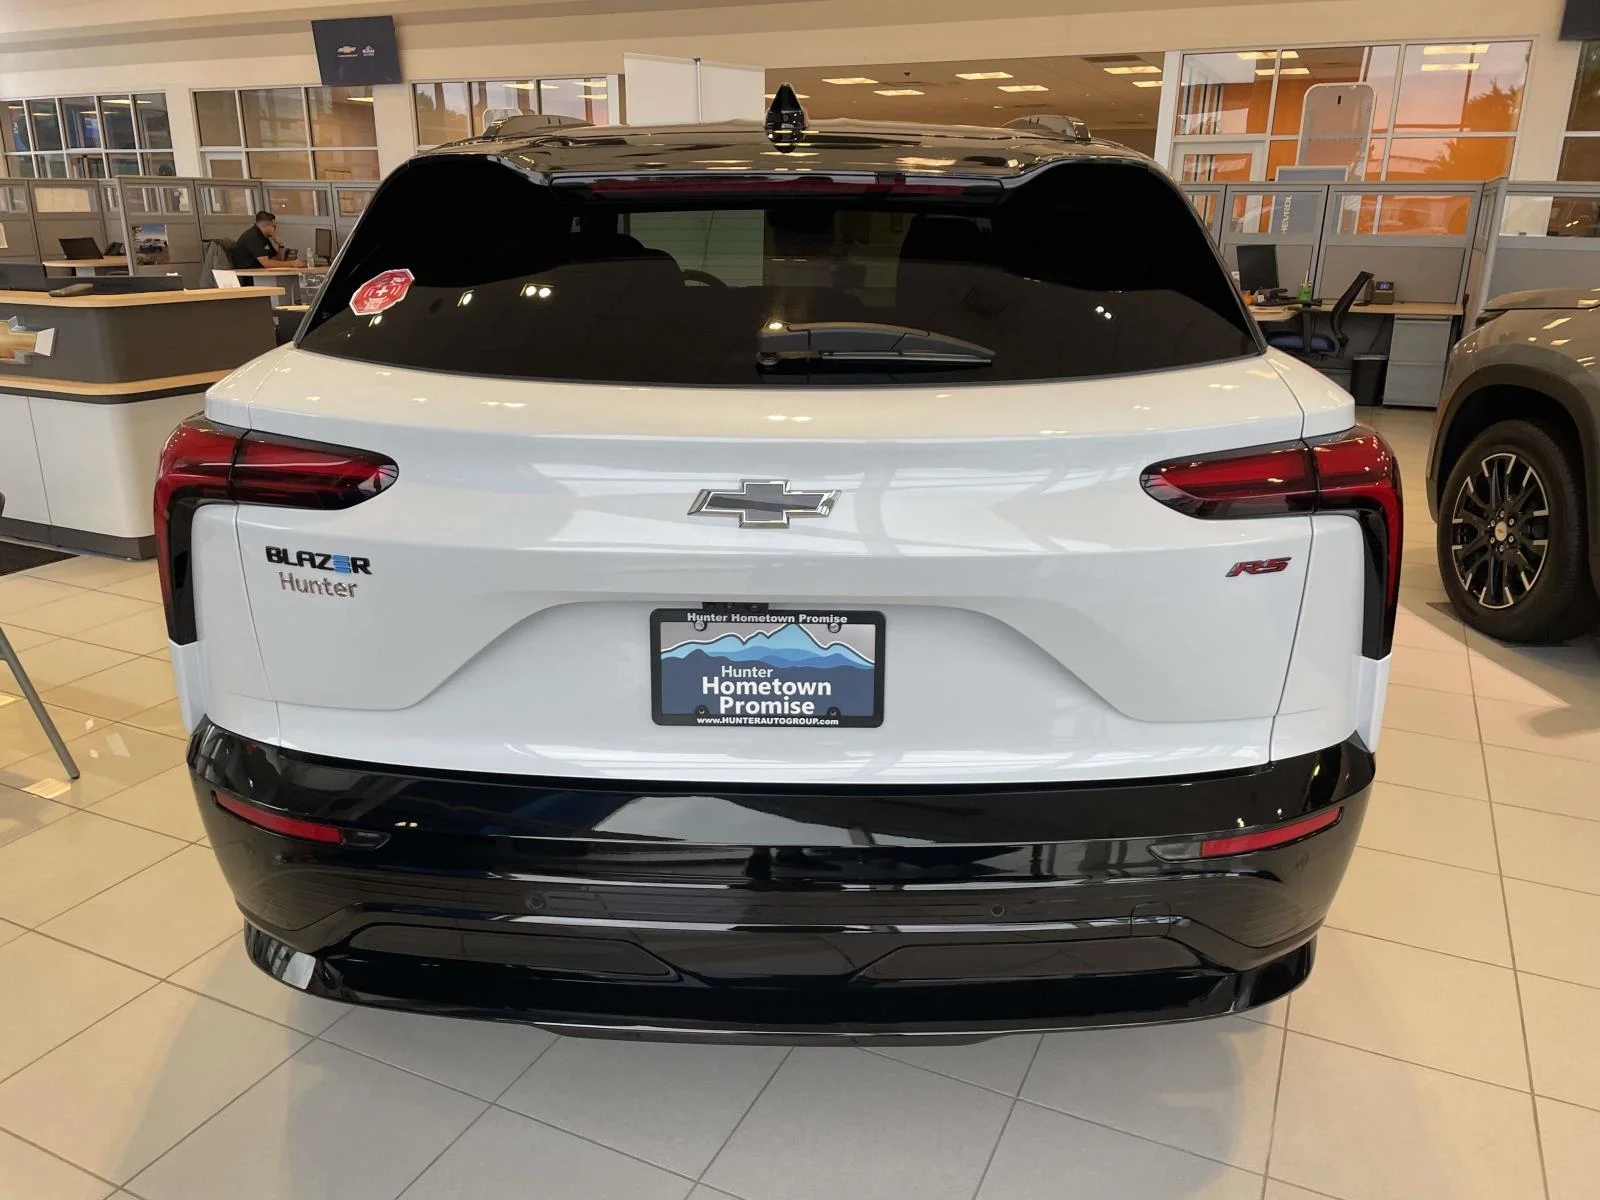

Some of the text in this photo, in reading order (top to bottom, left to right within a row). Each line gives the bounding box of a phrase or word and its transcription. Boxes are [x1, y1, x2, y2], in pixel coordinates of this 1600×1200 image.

[265, 545, 373, 575] BLAZER
[1225, 556, 1292, 577] RS
[278, 571, 358, 597] Hunter
[687, 612, 848, 623] Hunter Hometown Promise
[721, 665, 773, 678] Hunter
[702, 676, 832, 696] Hometown
[720, 696, 815, 715] Promise
[697, 717, 839, 725] www.HUNTERAUTOGROUP.com
